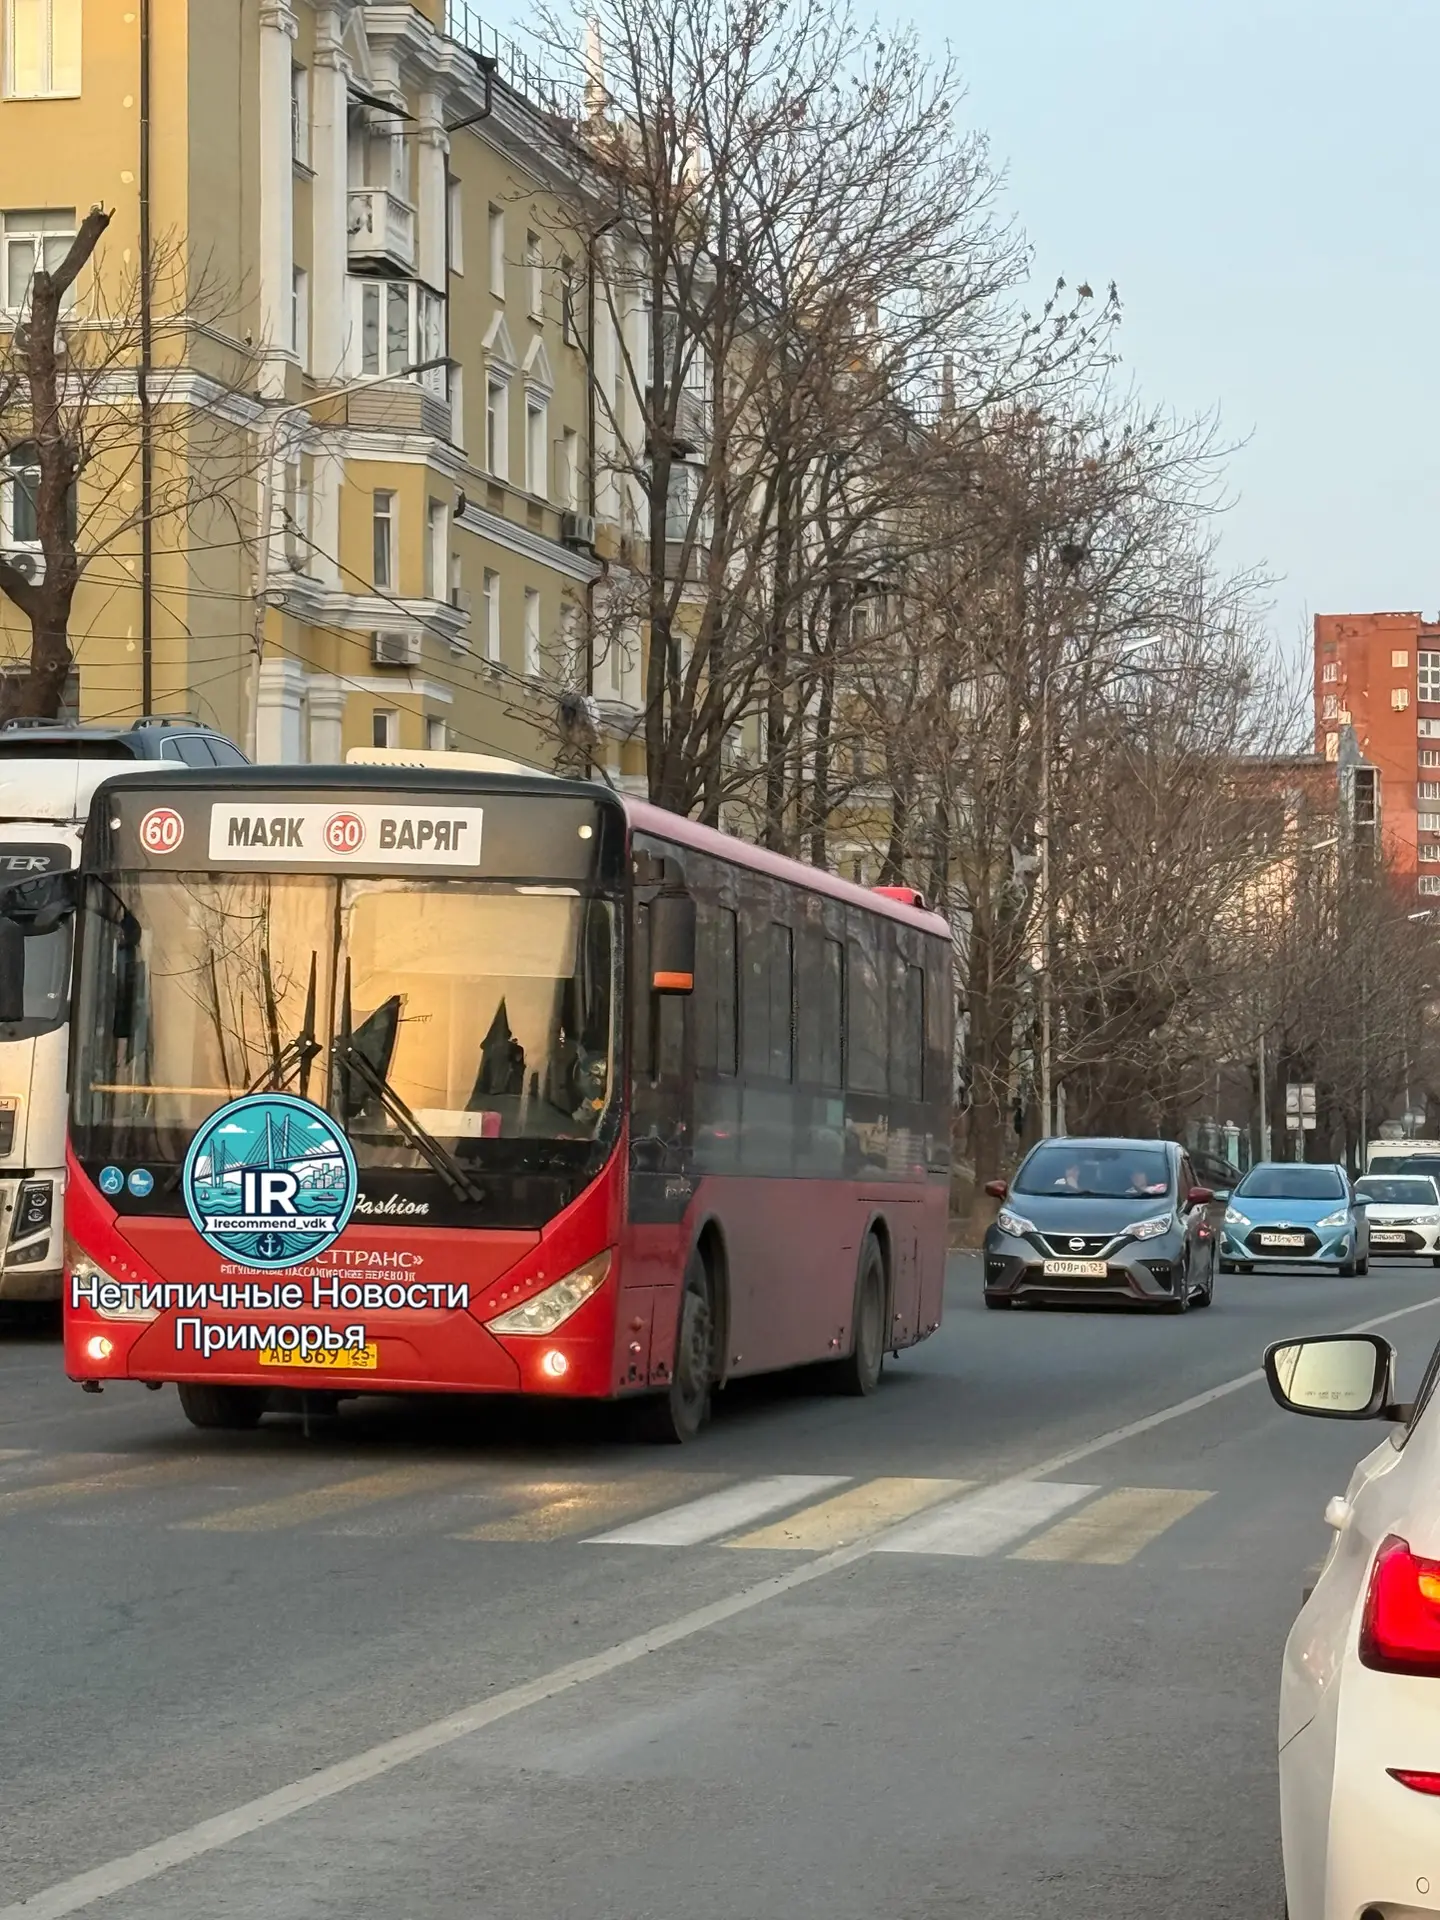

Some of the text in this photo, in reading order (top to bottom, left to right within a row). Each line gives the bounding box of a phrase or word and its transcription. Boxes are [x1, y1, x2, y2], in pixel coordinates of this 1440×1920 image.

[145, 817, 176, 846] 60
[227, 816, 468, 851] МАЯК 60 ВАРЯГ
[308, 1249, 424, 1268] СТТРАНС»
